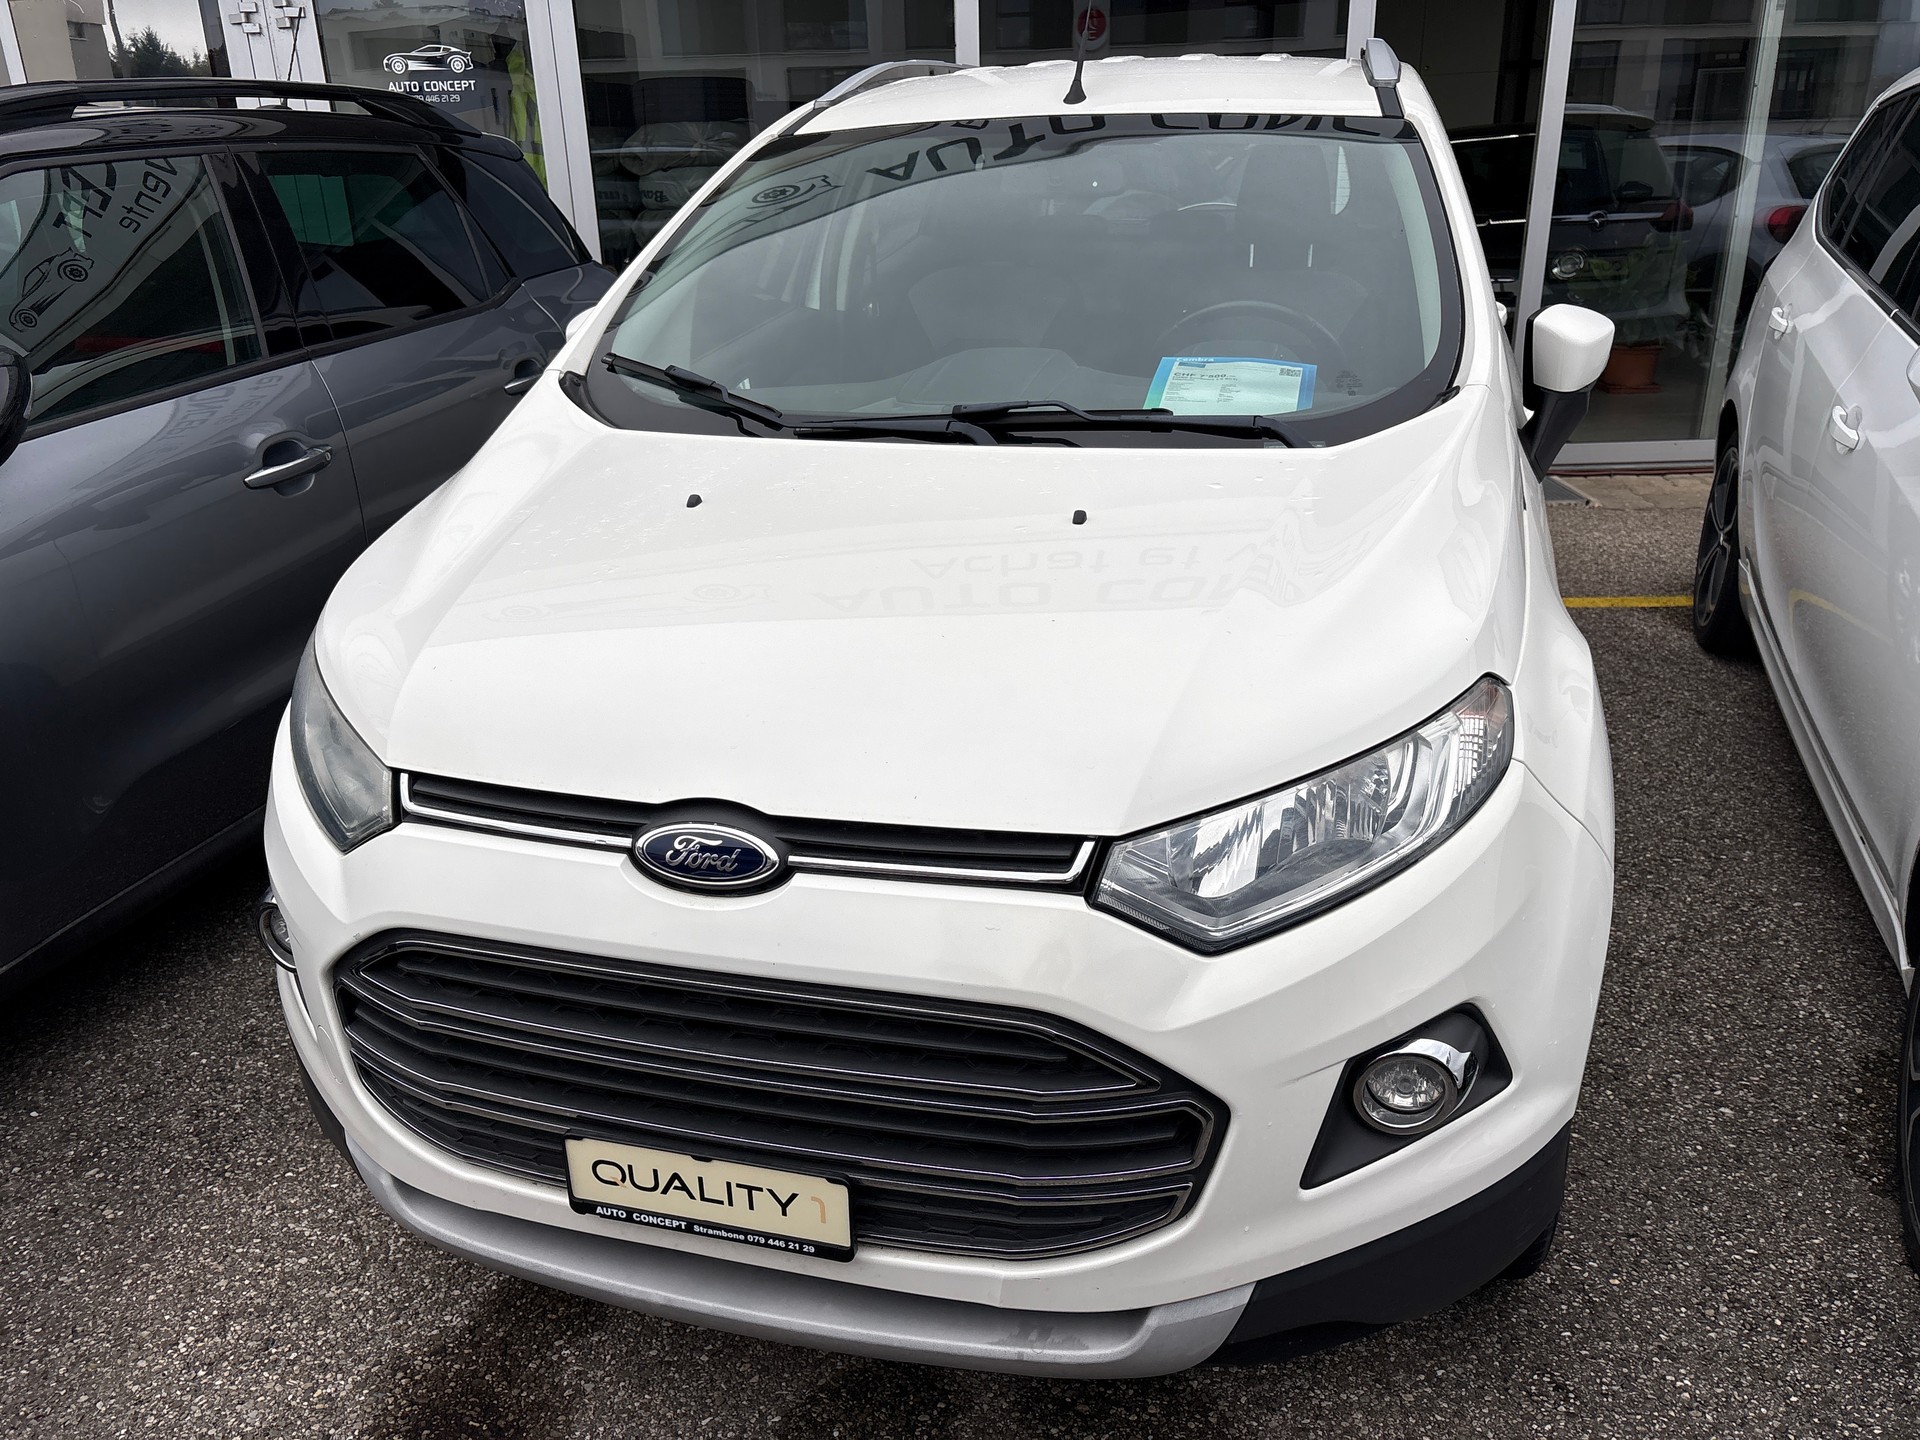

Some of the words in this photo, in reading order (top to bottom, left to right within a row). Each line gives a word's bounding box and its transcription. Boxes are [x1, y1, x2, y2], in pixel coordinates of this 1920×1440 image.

[388, 81, 420, 92] AUTO
[423, 80, 476, 92] CONCEPT
[425, 94, 441, 103] 446
[441, 94, 449, 103] 21
[450, 94, 461, 103] 29
[665, 835, 742, 872] Ford
[591, 1159, 800, 1217] QUALITY
[810, 1196, 827, 1224] 1
[595, 1205, 627, 1219] AUTO
[632, 1212, 688, 1230] CONCEPT
[693, 1224, 745, 1241] Strambone
[747, 1234, 765, 1245] 079
[767, 1238, 786, 1248] 446
[788, 1243, 800, 1251] 21
[802, 1245, 816, 1253] 29
